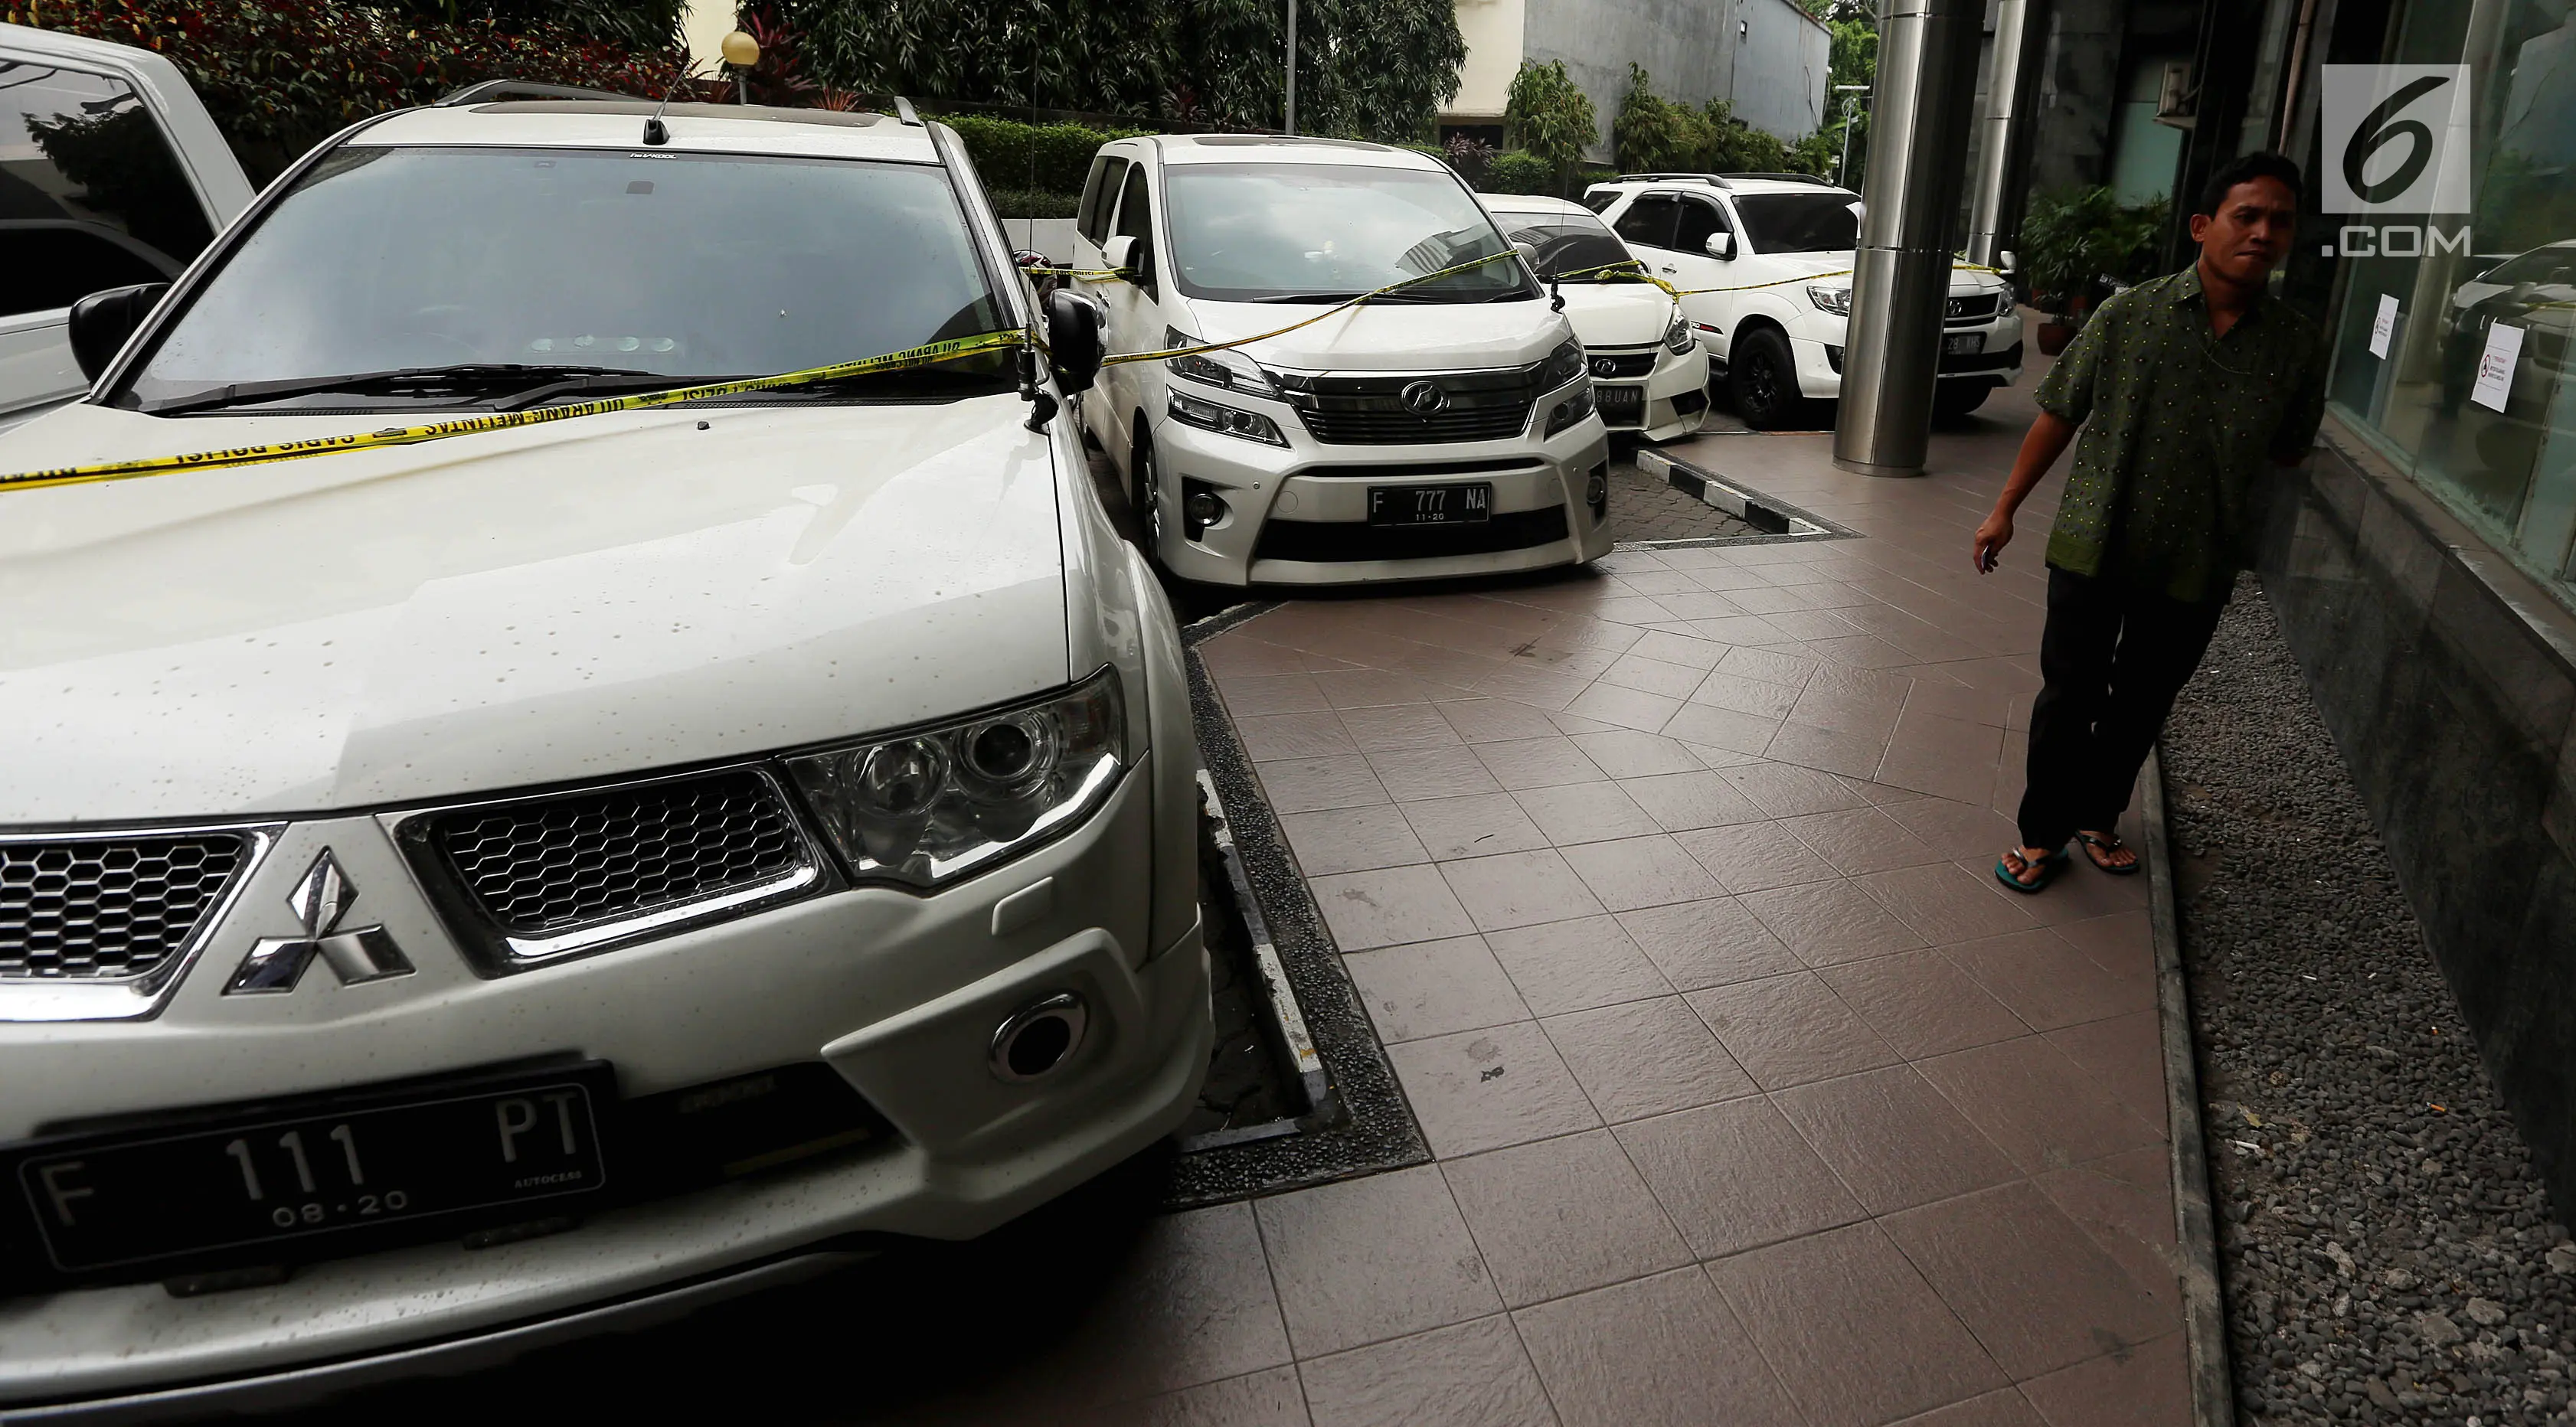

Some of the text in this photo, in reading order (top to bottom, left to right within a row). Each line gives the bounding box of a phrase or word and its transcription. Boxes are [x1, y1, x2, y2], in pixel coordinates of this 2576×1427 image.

[1947, 337, 1959, 350] 28
[1373, 488, 1486, 514] F 777 NA
[39, 1090, 579, 1227] F 111 PT
